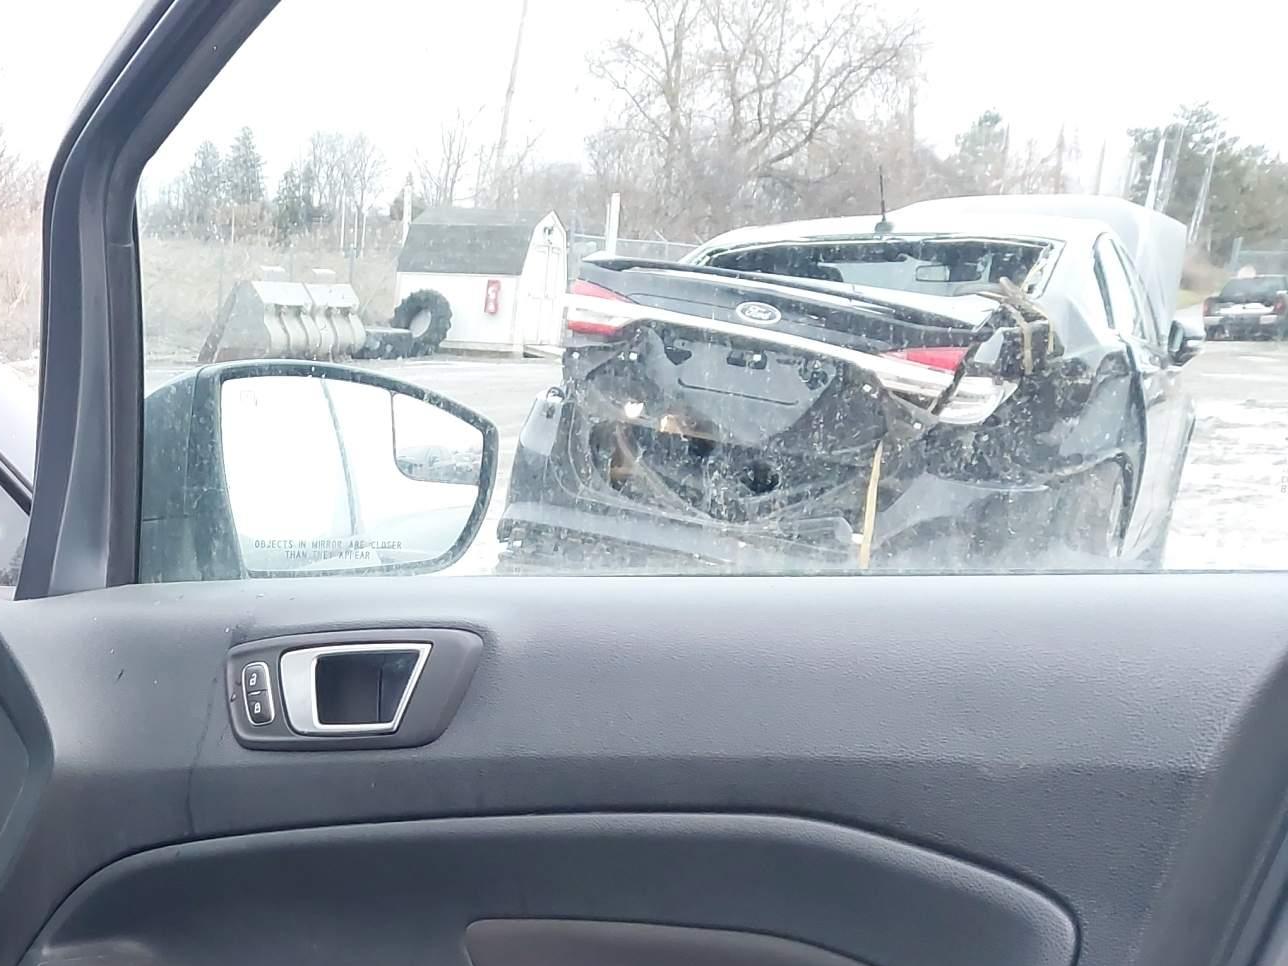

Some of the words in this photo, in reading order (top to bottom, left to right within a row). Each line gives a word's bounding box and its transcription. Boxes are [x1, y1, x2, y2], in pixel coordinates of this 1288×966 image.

[254, 539, 293, 549] OBJECTS
[298, 539, 306, 548] IN
[312, 539, 343, 549] MIRROR
[285, 550, 307, 560] THAN
